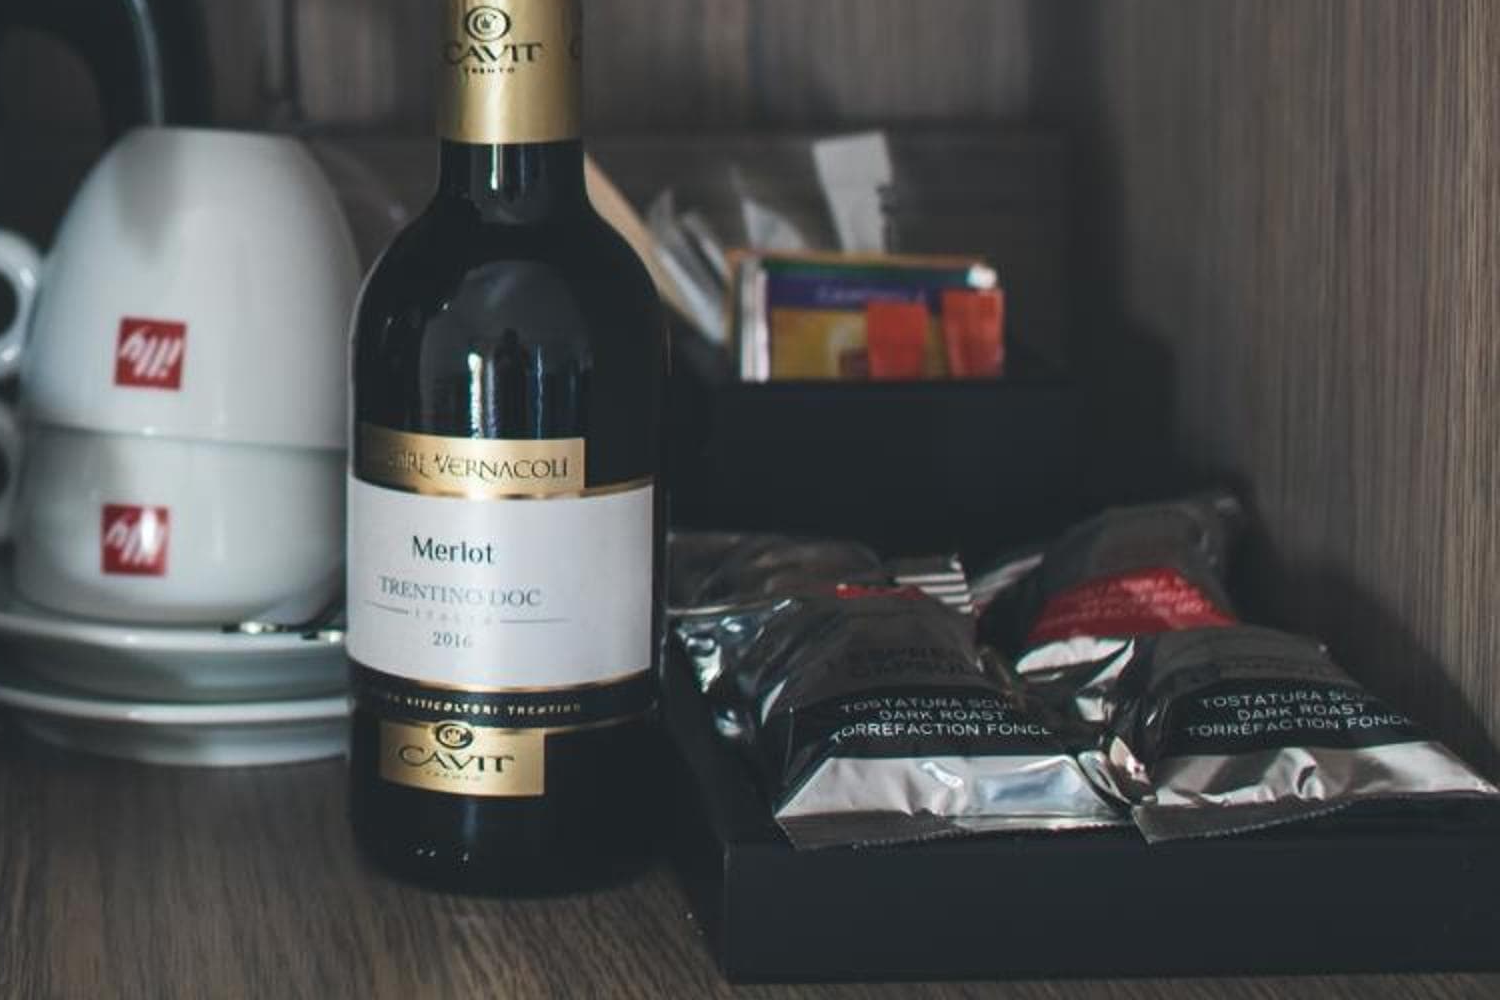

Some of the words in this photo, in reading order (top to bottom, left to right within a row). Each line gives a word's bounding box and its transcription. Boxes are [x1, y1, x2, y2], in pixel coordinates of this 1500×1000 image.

[443, 41, 544, 65] CAVIT
[433, 453, 568, 482] VERNACOLI
[411, 535, 496, 566] Merlot
[377, 575, 485, 607] TRENTINO
[489, 587, 542, 608] DOC
[431, 629, 474, 650] 2016
[879, 709, 933, 722] DARK
[940, 709, 1005, 722] ROAST
[1237, 708, 1294, 722] DARK
[1299, 702, 1365, 717] ROAST
[398, 745, 516, 774] CAVIT
